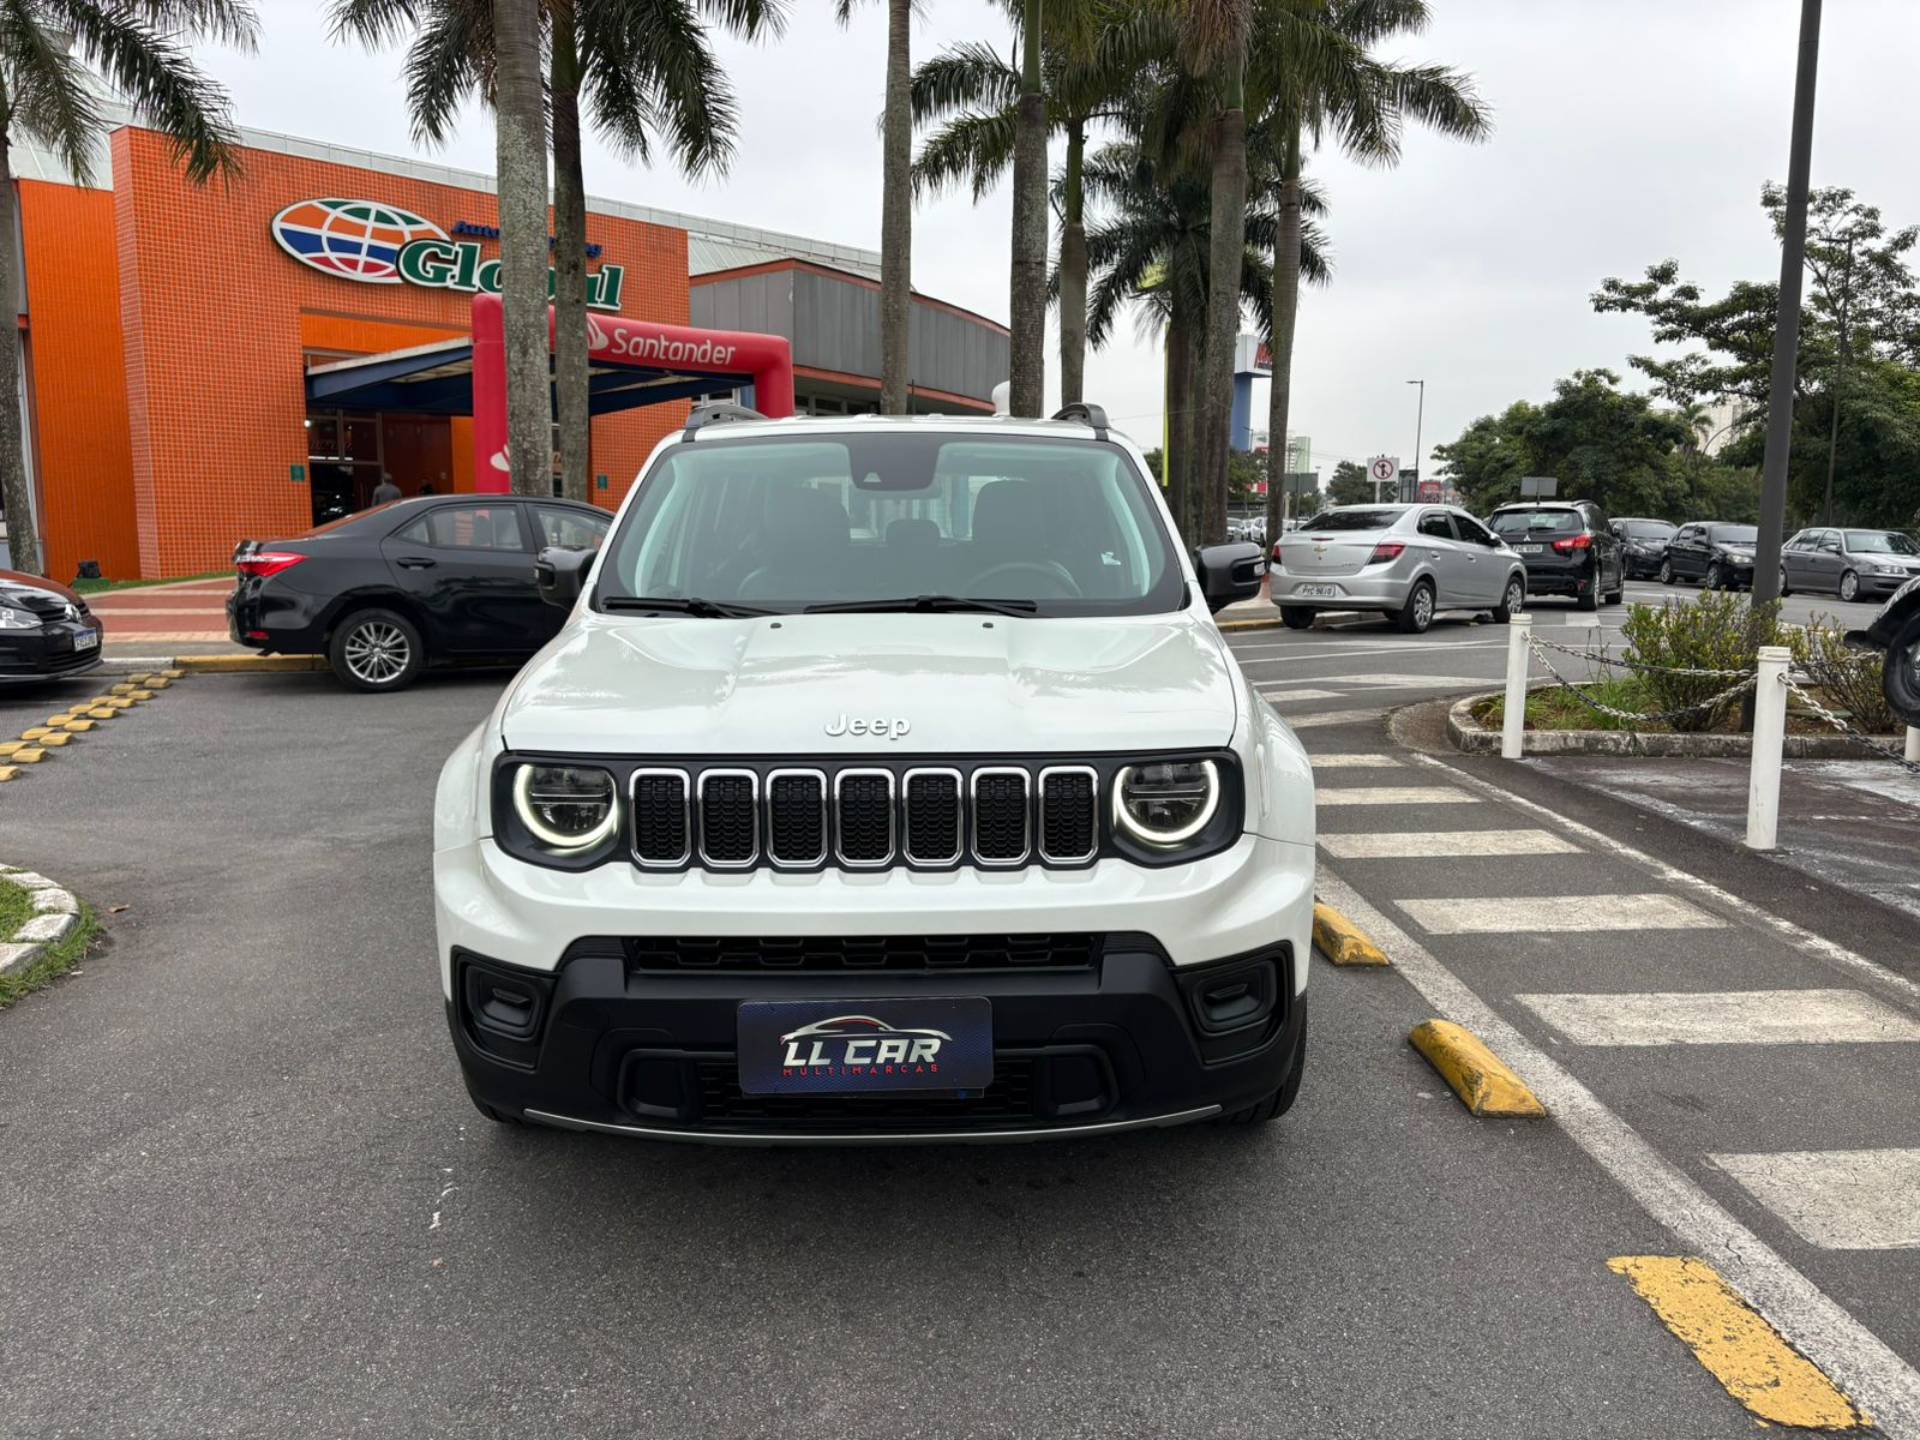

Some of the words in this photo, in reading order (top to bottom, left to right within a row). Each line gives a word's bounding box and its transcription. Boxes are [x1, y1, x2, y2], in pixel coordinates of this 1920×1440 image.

[399, 239, 624, 311] Glol
[611, 328, 736, 365] Santander
[824, 711, 911, 741] Jeep
[783, 1042, 832, 1066] LL
[844, 1038, 941, 1064] CAR
[783, 1064, 939, 1077] MULTIMARCAS
